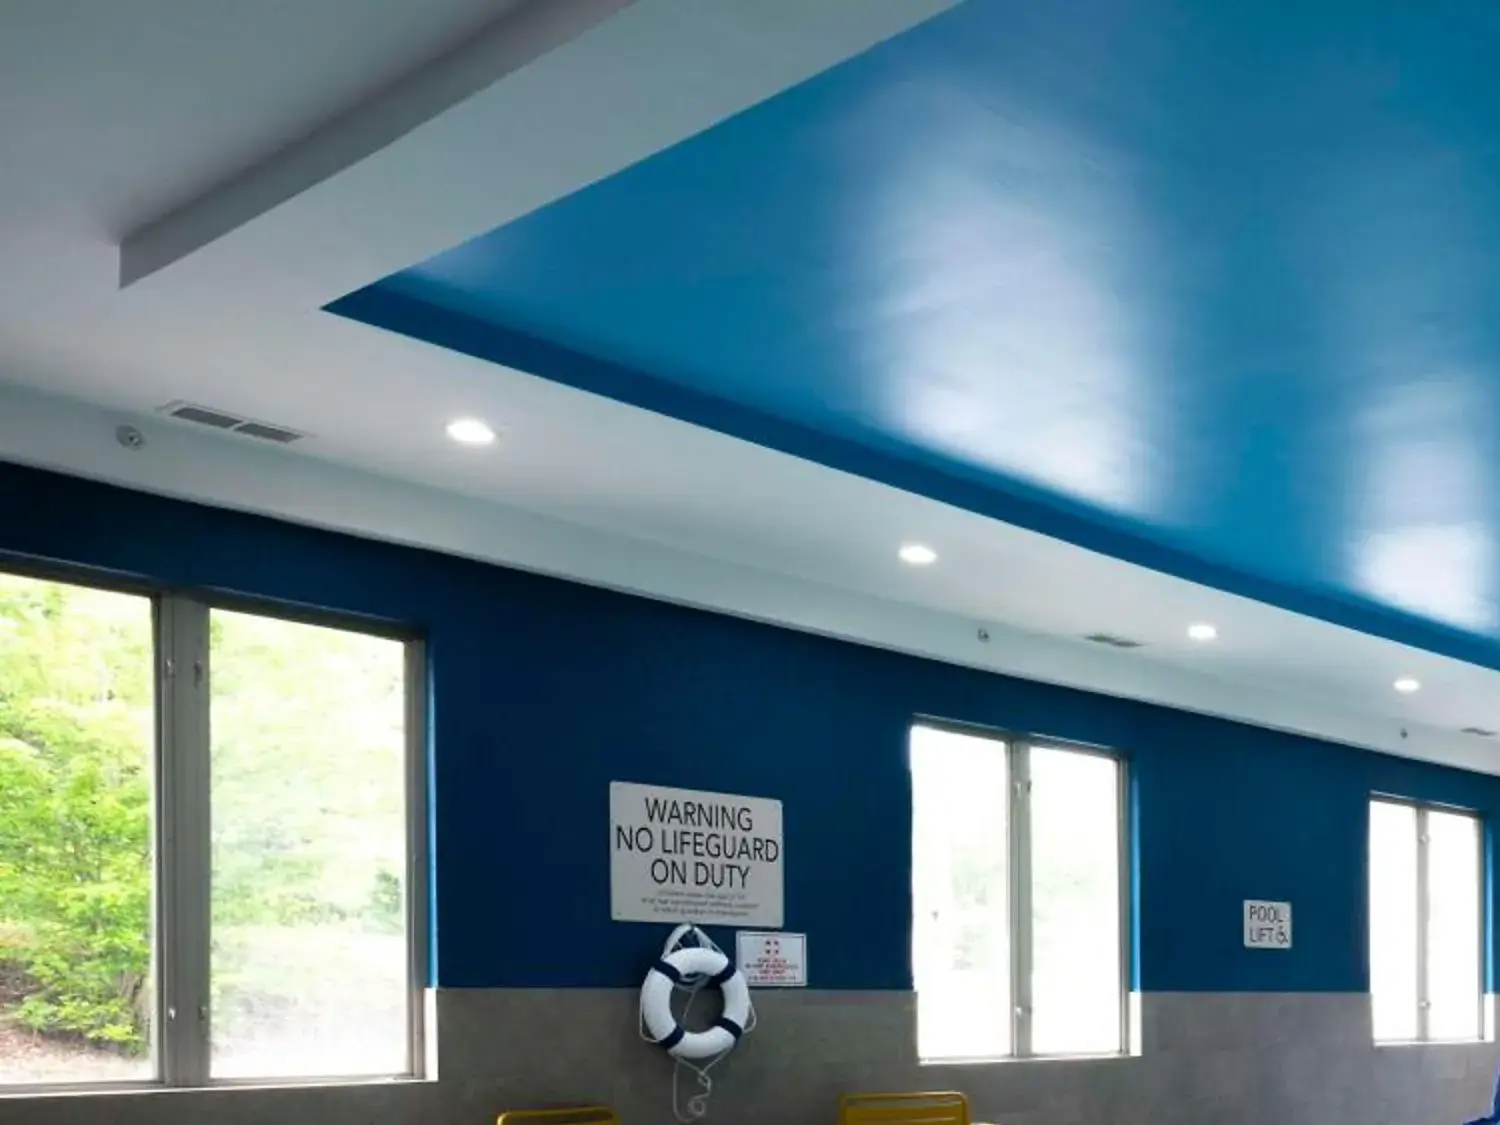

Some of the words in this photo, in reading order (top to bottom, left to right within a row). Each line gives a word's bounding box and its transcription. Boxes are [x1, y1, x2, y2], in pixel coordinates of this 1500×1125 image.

[645, 797, 753, 832] WARNING
[616, 825, 653, 853] NO
[661, 829, 779, 863] LIFEGUARD
[651, 858, 687, 885] ON
[695, 861, 751, 889] DUTY
[1249, 905, 1283, 923] POOL
[1249, 926, 1274, 943] LIFT
